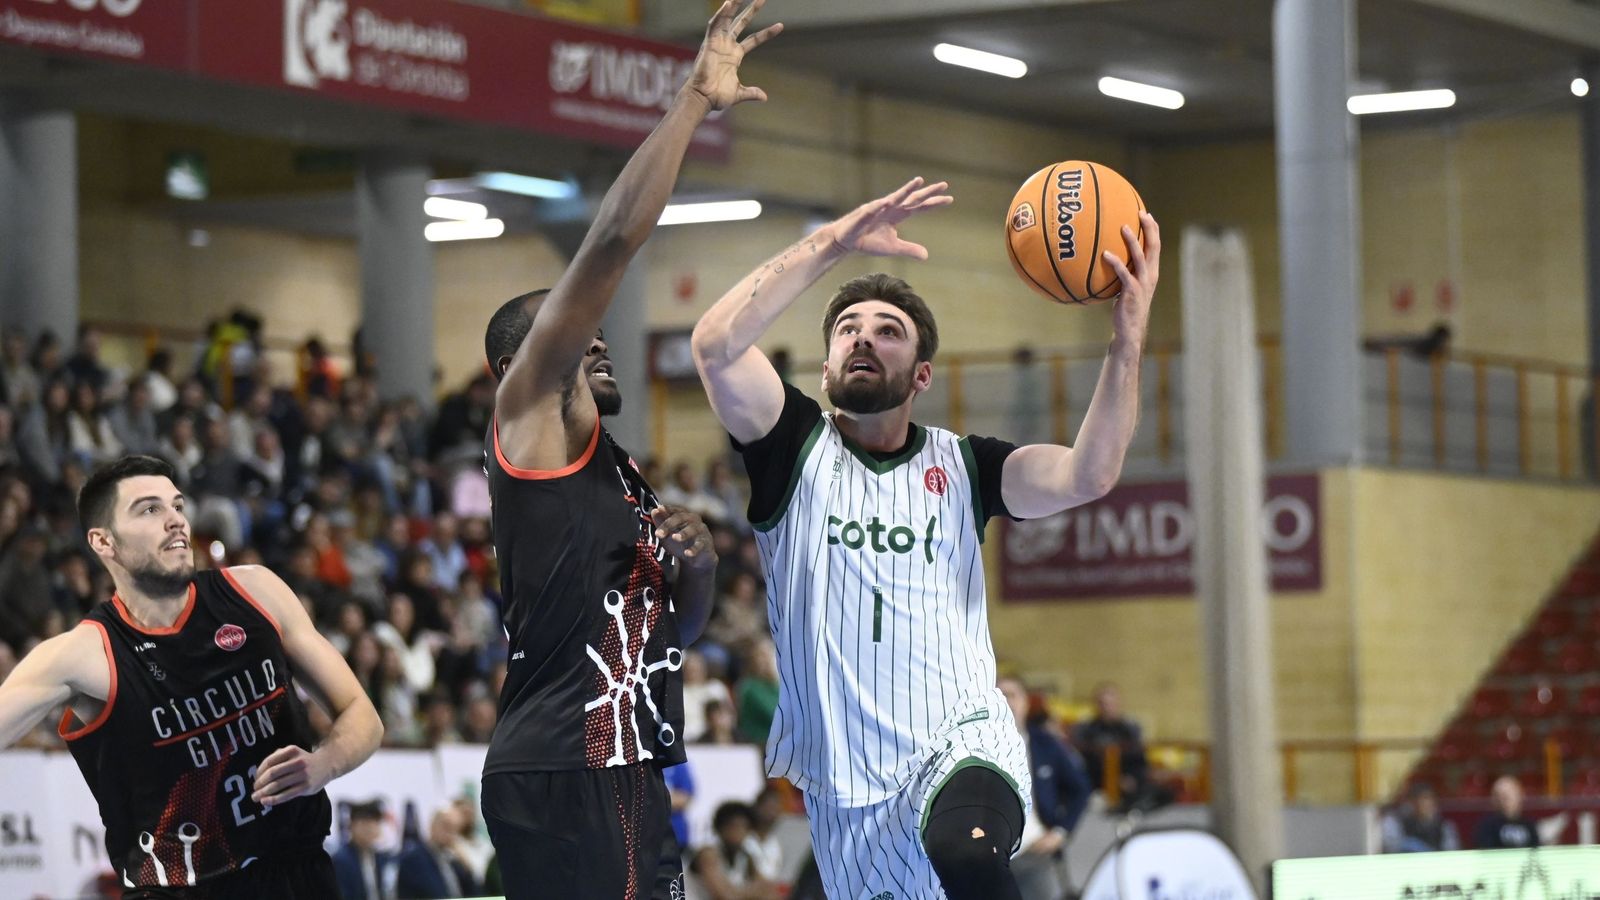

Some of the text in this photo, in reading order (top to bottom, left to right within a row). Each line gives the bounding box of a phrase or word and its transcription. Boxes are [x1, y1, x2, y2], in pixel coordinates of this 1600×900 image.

[1057, 169, 1083, 261] Wilson
[151, 658, 277, 740] CÍRCULO
[187, 704, 276, 769] GIJÓN
